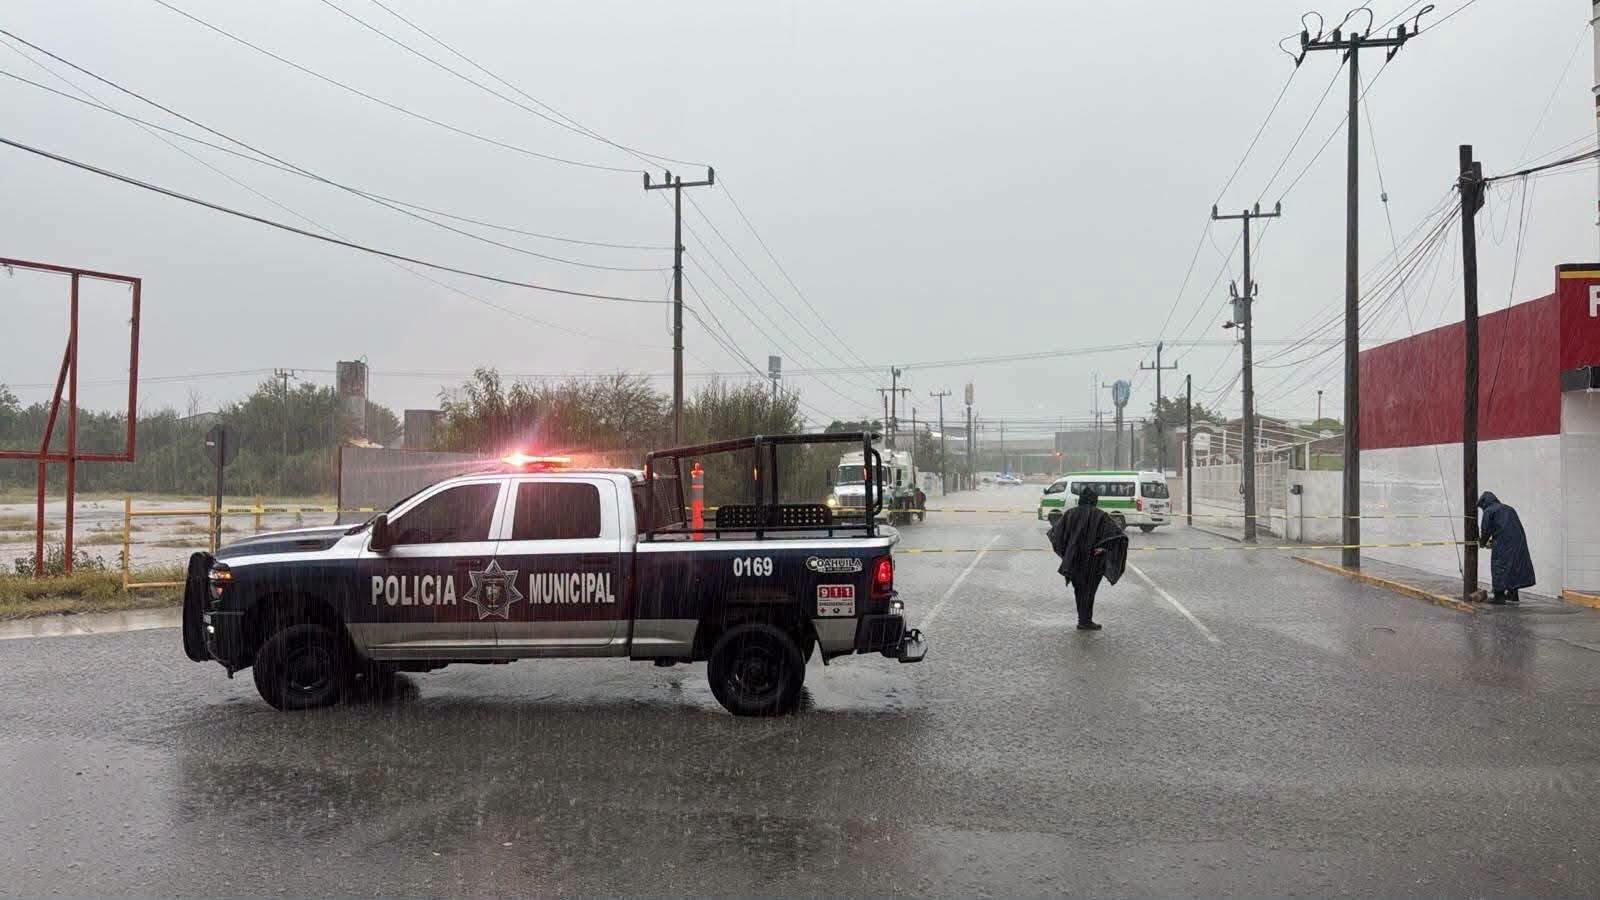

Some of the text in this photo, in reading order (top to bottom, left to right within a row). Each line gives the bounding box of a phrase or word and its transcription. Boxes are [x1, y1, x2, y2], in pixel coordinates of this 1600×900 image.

[733, 557, 773, 576] 0169
[371, 572, 616, 605] POLICIA MUNICIPAL
[821, 587, 851, 598] 911
